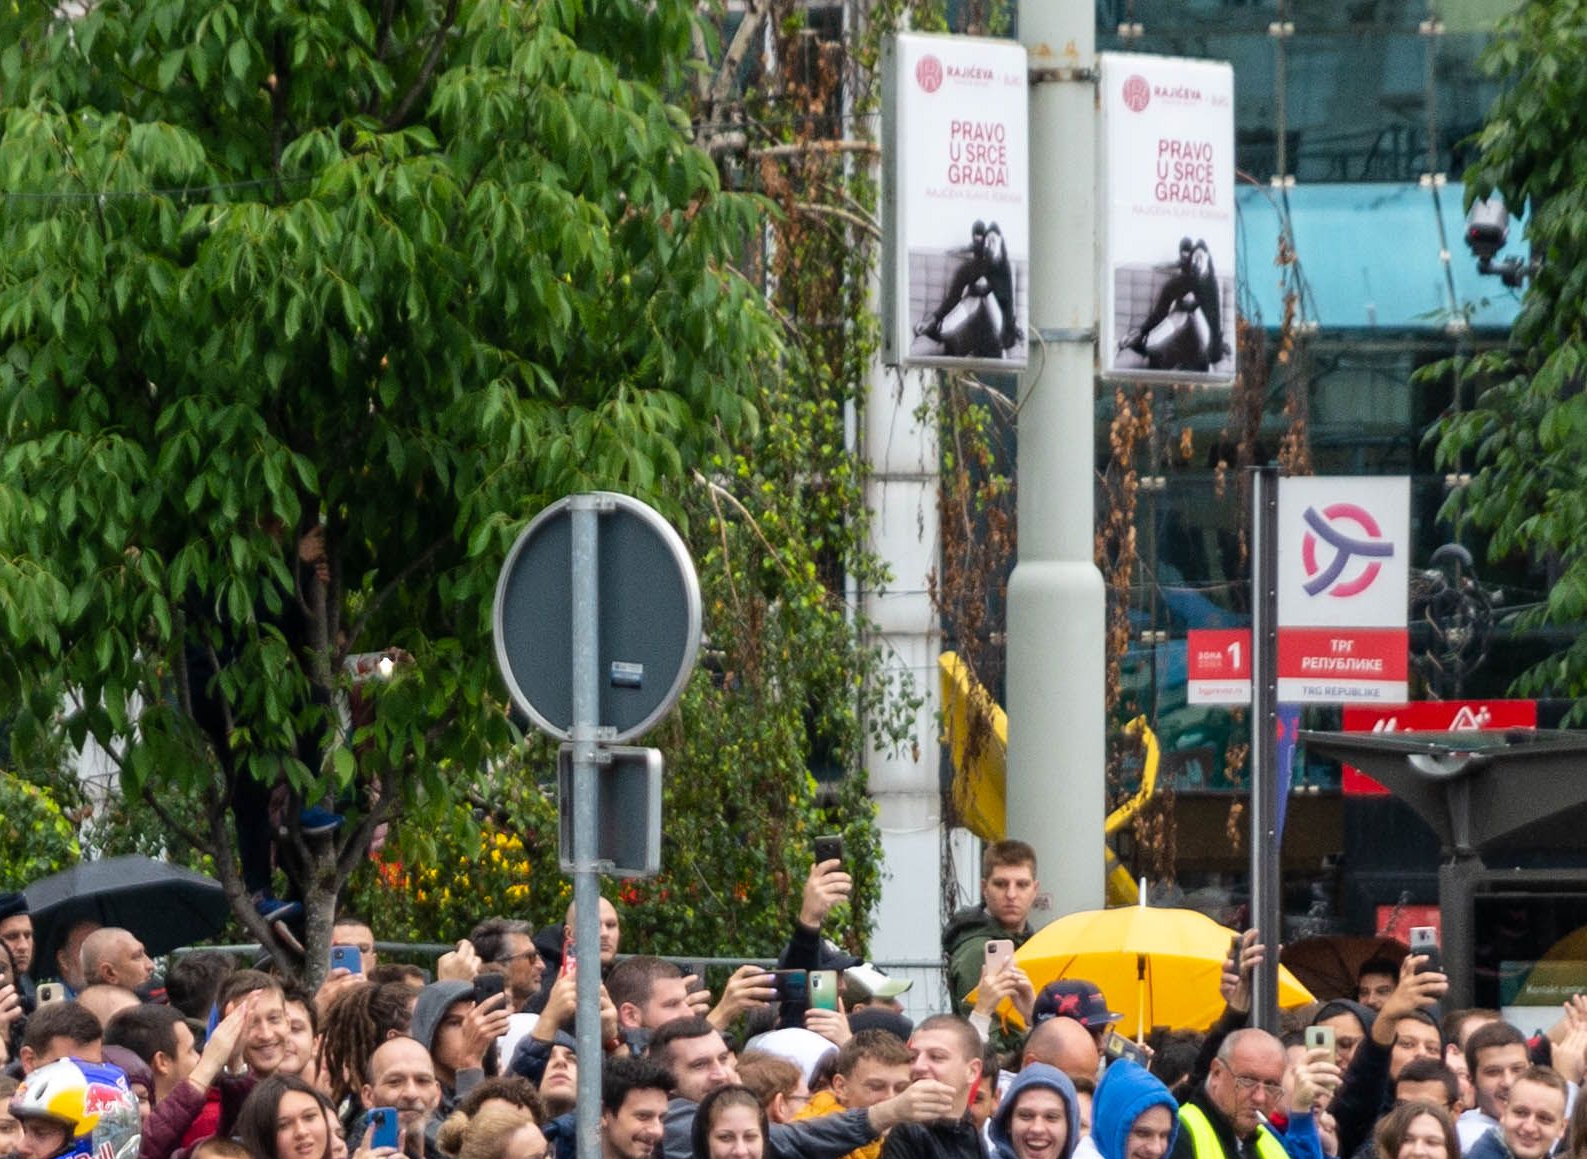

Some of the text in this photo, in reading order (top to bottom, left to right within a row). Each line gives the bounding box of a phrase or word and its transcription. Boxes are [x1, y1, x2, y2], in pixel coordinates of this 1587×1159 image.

[947, 65, 994, 81] RAJIĆEVA
[1154, 85, 1201, 101] RAJIĆEVA
[950, 120, 1006, 143] PRAVO
[949, 141, 1007, 165] U SRCE
[1158, 139, 1214, 163] PRAVO
[947, 164, 1010, 187] GRADA!
[1157, 159, 1215, 184] U SRCE
[1155, 182, 1216, 206] GRADA!
[1227, 641, 1241, 671] 1
[1330, 639, 1355, 652] ТРГ
[1301, 656, 1383, 672] РЕПУБЛИКЕ
[1302, 686, 1381, 697] TRG REPUBLIKE
